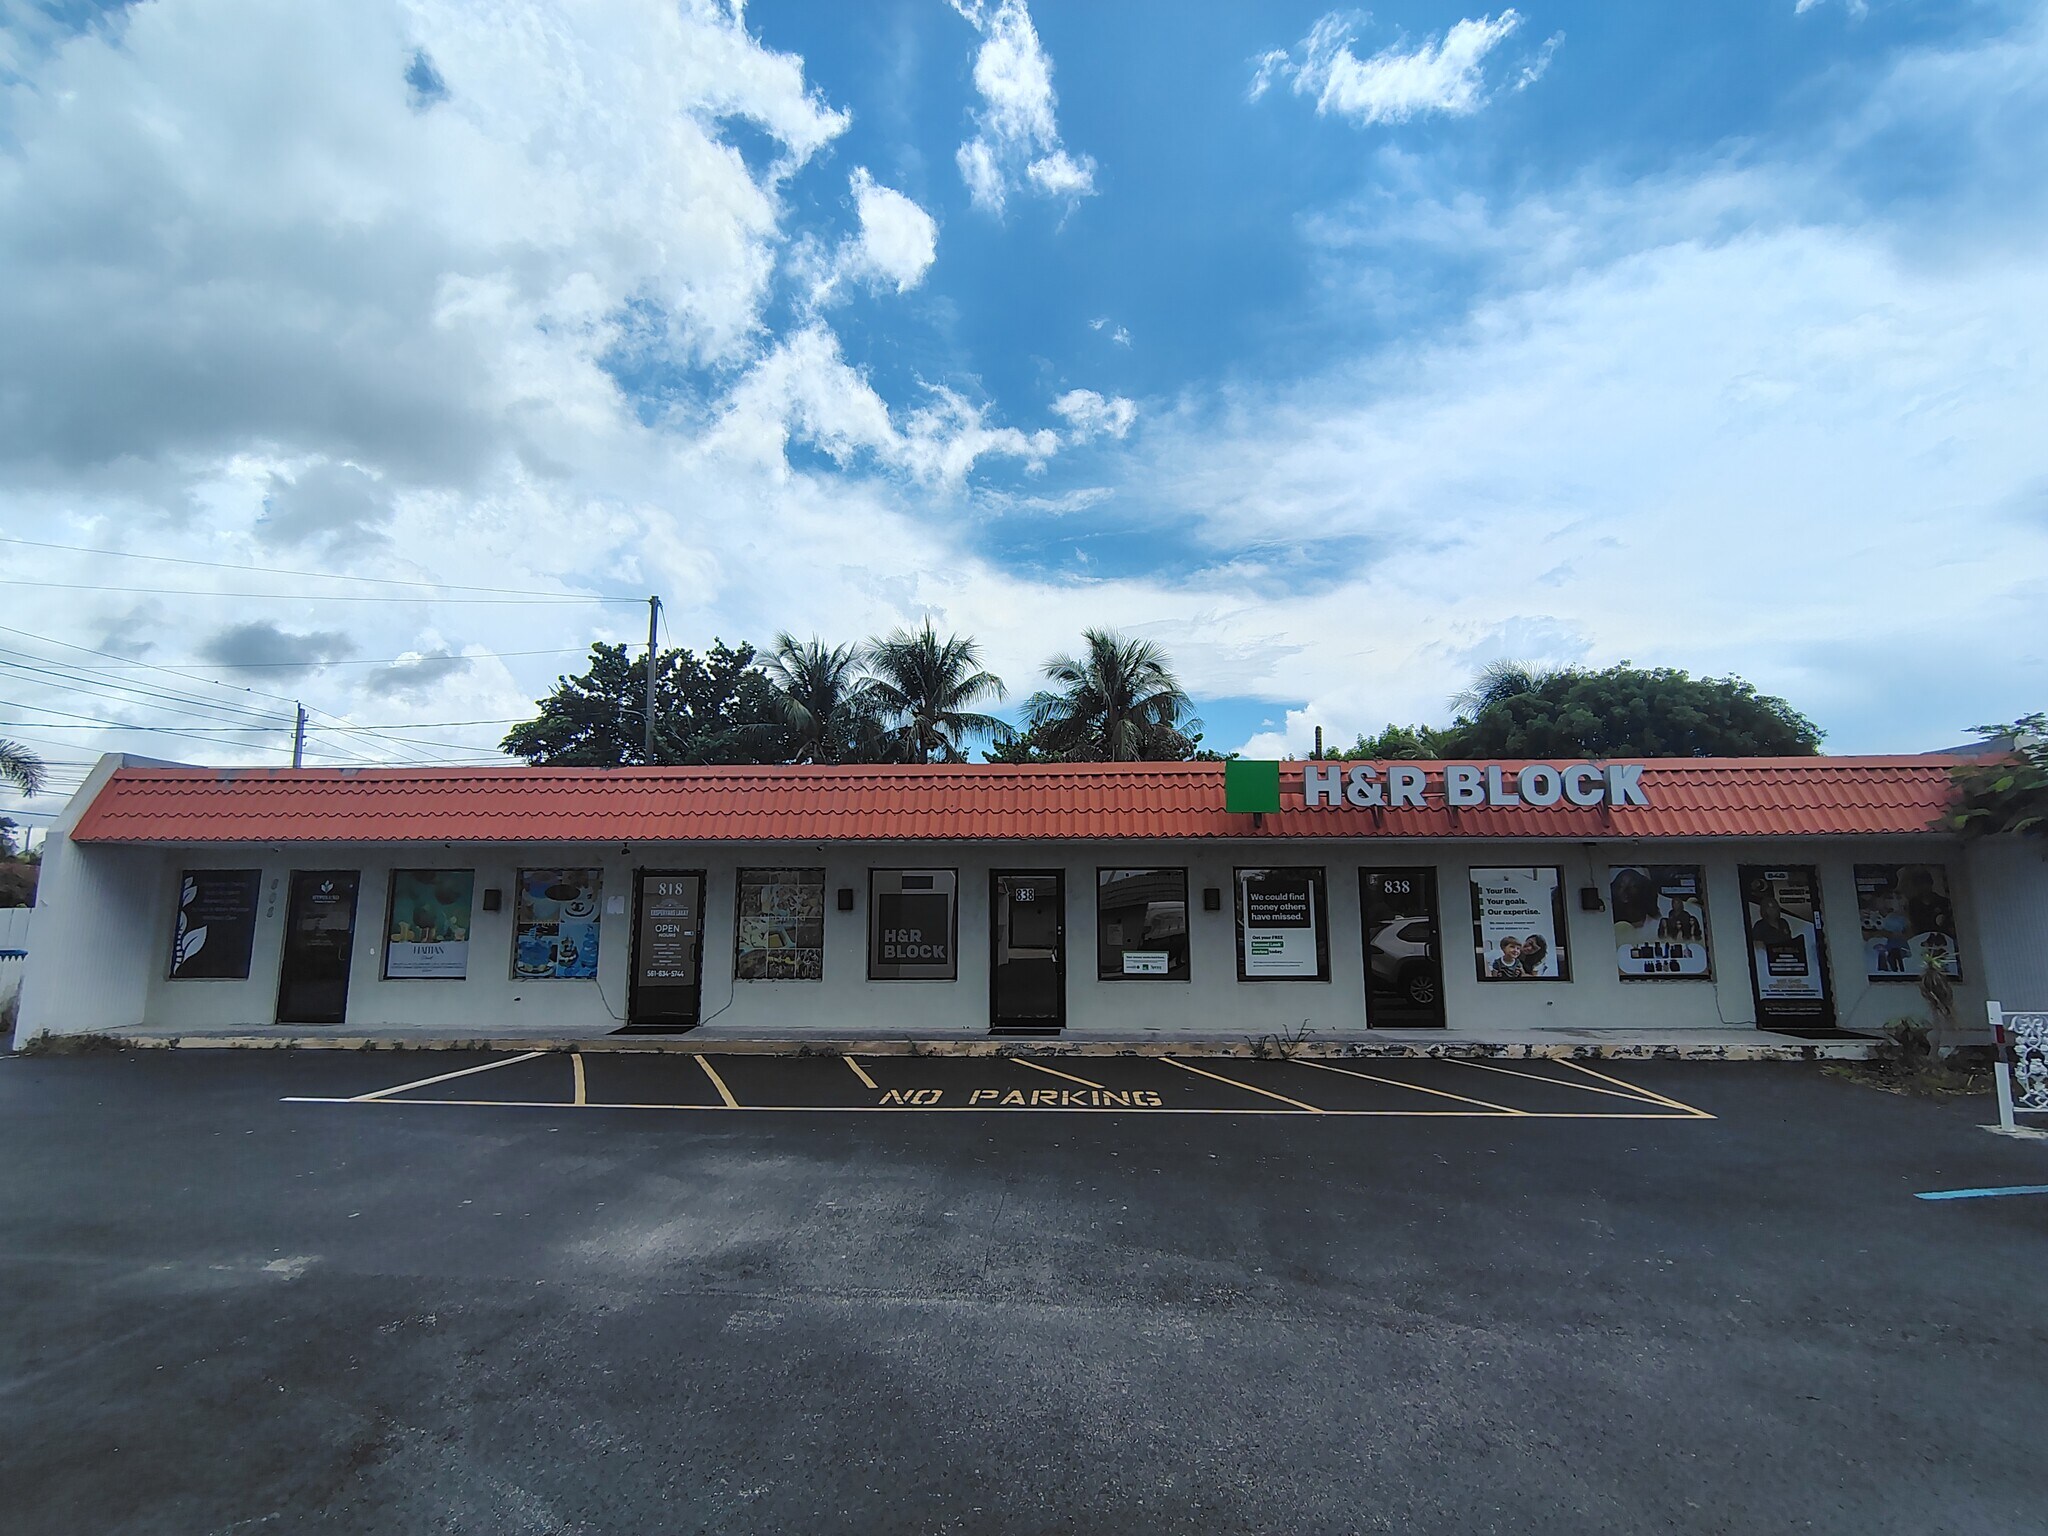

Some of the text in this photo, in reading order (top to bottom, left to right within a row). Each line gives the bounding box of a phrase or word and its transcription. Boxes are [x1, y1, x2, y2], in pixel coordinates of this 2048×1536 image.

[1304, 764, 1650, 806] H&R BLOCK
[658, 882, 683, 896] 818
[1384, 880, 1410, 894] 838
[1016, 889, 1034, 901] 838
[1250, 892, 1305, 901] We could find
[1250, 903, 1306, 912] money others
[1505, 897, 1528, 906] goals.
[1251, 912, 1304, 921] have missed.
[1503, 908, 1541, 917] expertise.
[655, 924, 680, 933] OPEN
[884, 929, 922, 943] H&R
[884, 944, 946, 958] BLOCK
[878, 1089, 1164, 1107] NO PARKING
